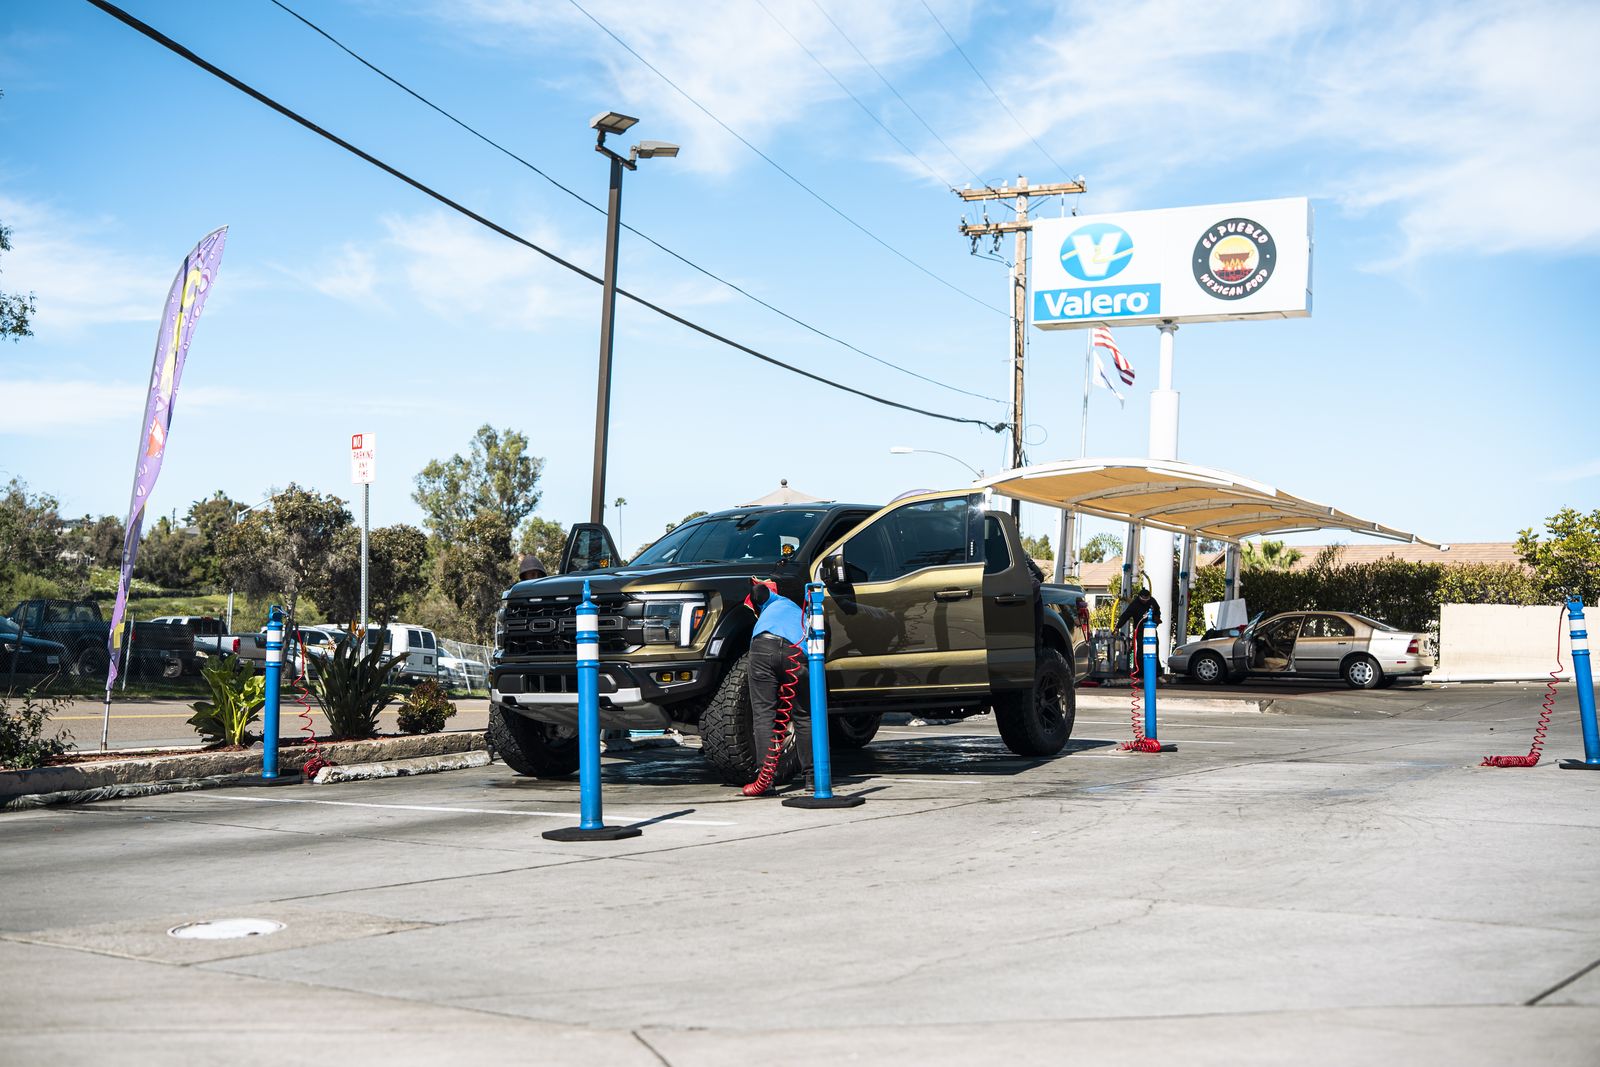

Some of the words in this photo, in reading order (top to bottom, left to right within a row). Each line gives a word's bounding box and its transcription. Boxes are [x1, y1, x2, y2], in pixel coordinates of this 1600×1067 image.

[1202, 232, 1217, 249] EL
[1217, 222, 1269, 243] PUEBLO
[1200, 273, 1244, 296] MEXICAN
[1245, 269, 1268, 291] FOOD
[1044, 290, 1148, 317] Valero
[352, 435, 362, 448] NO
